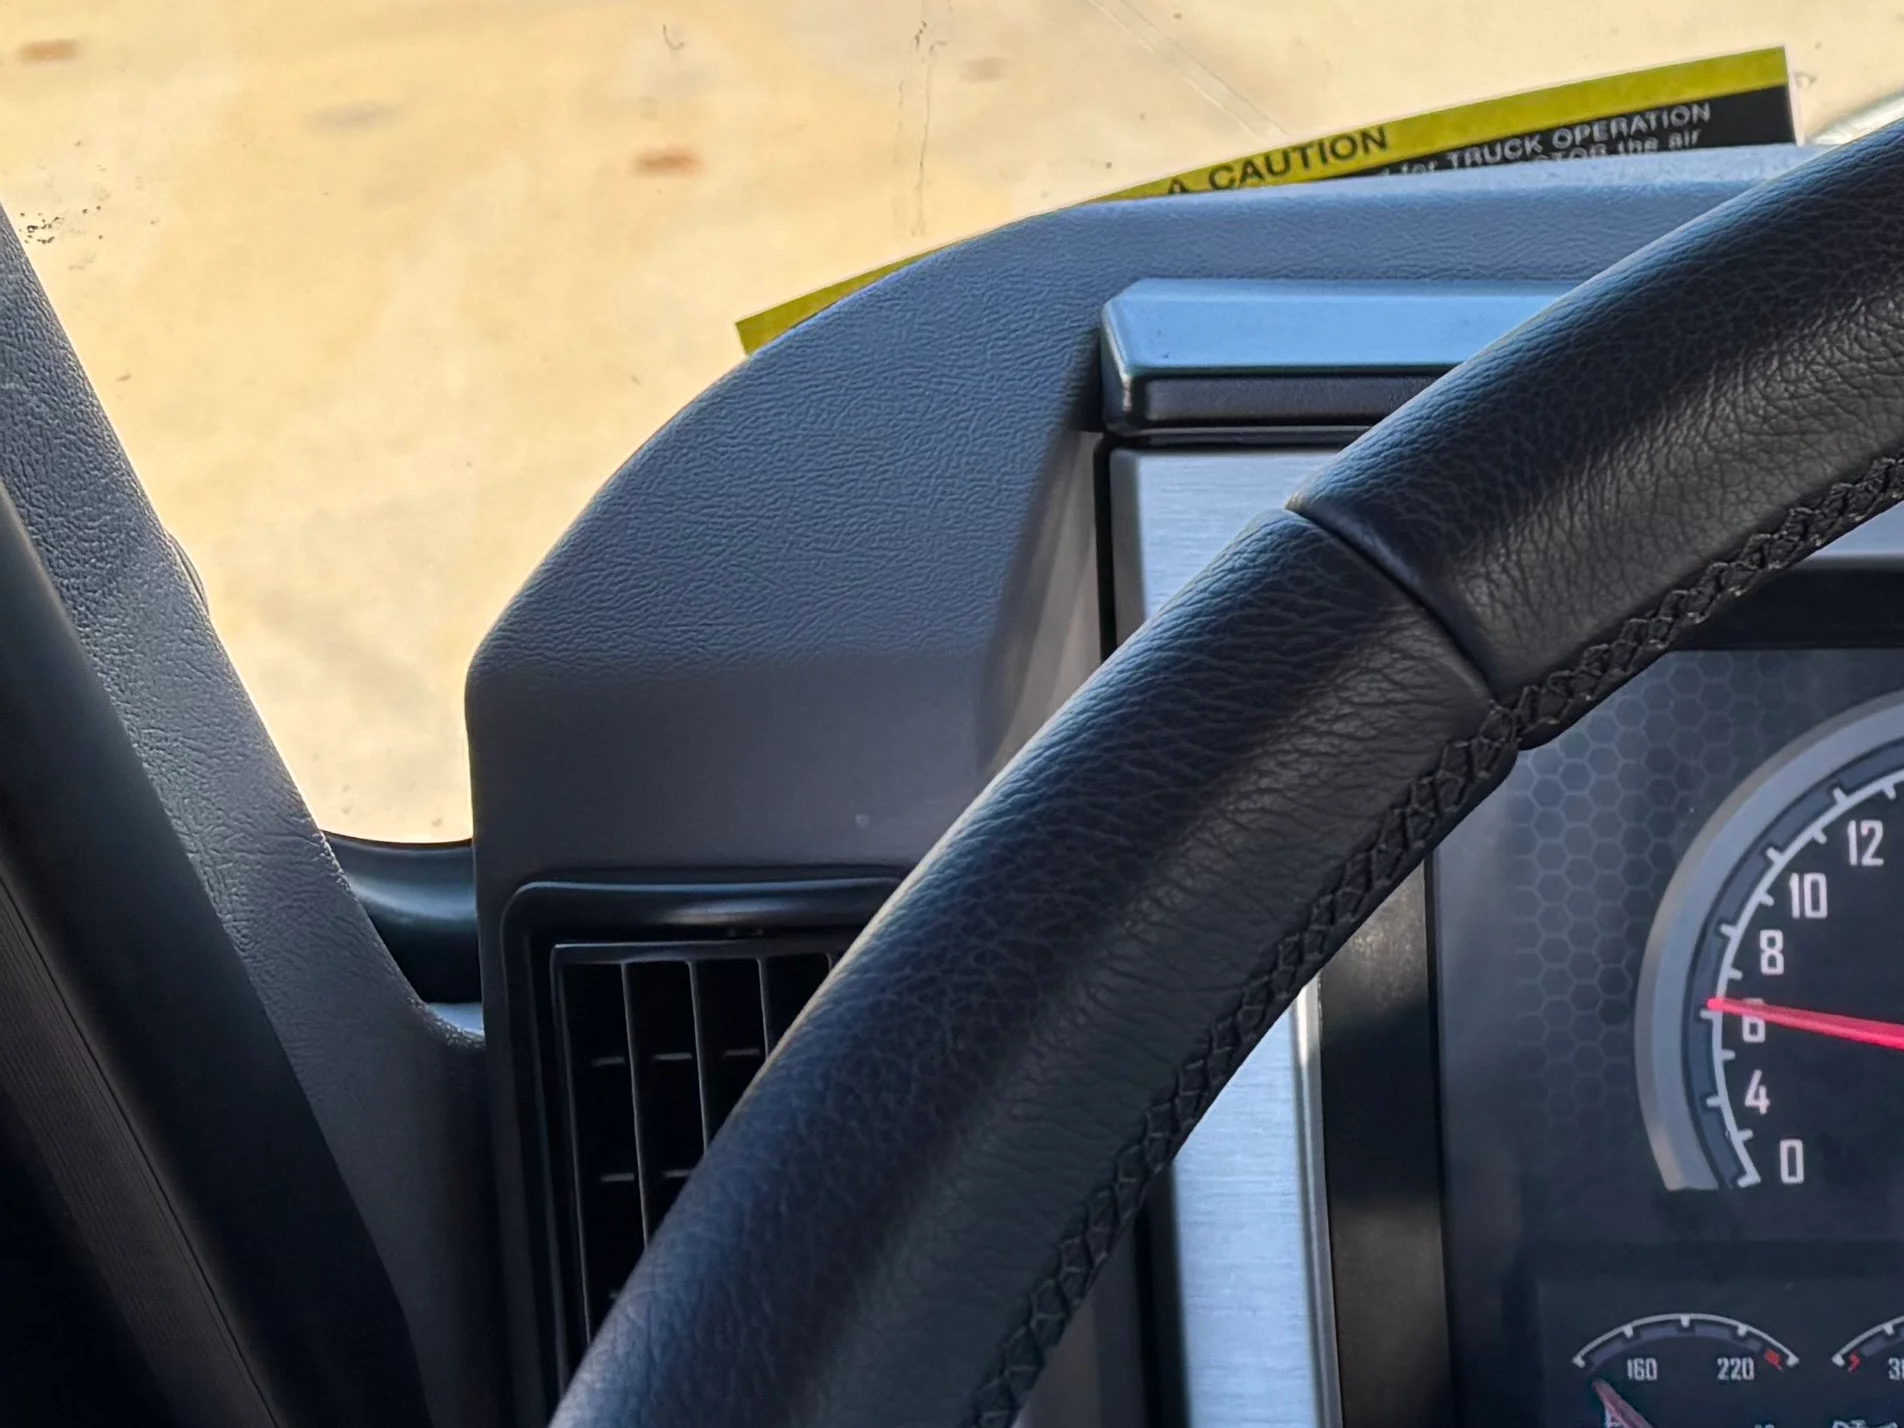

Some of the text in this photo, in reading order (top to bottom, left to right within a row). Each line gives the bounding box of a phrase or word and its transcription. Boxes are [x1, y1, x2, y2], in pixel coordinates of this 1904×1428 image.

[1208, 125, 1388, 190] CAUTION
[1447, 134, 1544, 168] TRUCK
[1552, 102, 1711, 150] OPERATION
[1847, 819, 1884, 866] 12
[1789, 872, 1828, 918] 10
[1759, 929, 1784, 975] 8
[1744, 1069, 1770, 1115] 4
[1779, 1139, 1804, 1184] 0
[1627, 1357, 1658, 1381] 160
[1717, 1357, 1755, 1381] 220
